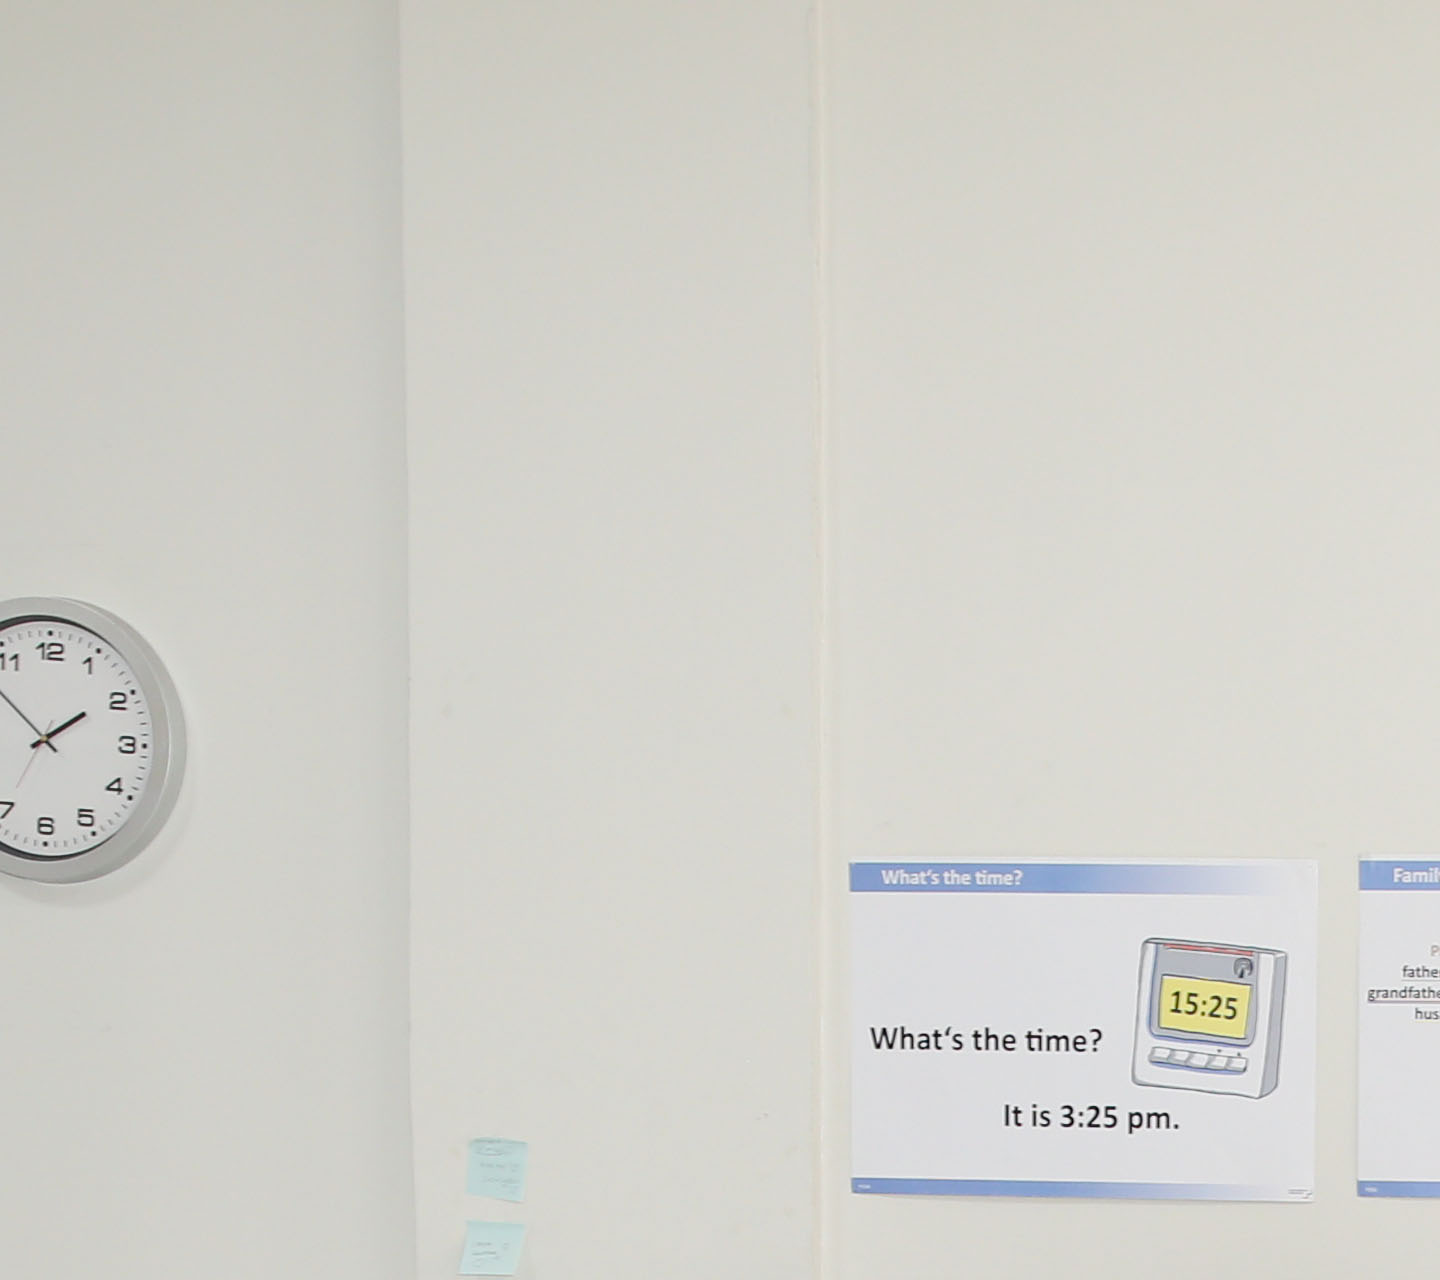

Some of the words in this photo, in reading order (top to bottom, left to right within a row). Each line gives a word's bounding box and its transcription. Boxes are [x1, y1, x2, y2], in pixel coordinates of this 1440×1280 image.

[35, 642, 65, 661] 12
[82, 657, 93, 675] 1
[109, 692, 127, 711] 2
[118, 735, 136, 754] 3
[105, 777, 123, 795] 4
[37, 816, 54, 835] 6
[77, 808, 94, 827] 5
[881, 869, 939, 886] What's
[944, 869, 972, 886] the
[975, 870, 1023, 887] time?
[1169, 990, 1238, 1021] 15:25
[871, 1027, 963, 1052] What's
[972, 1027, 1016, 1051] the
[1026, 1028, 1102, 1053] time?
[1004, 1104, 1022, 1127] It
[1031, 1104, 1051, 1127] is
[1060, 1105, 1117, 1129] 3:25
[1127, 1109, 1180, 1134] pm.
